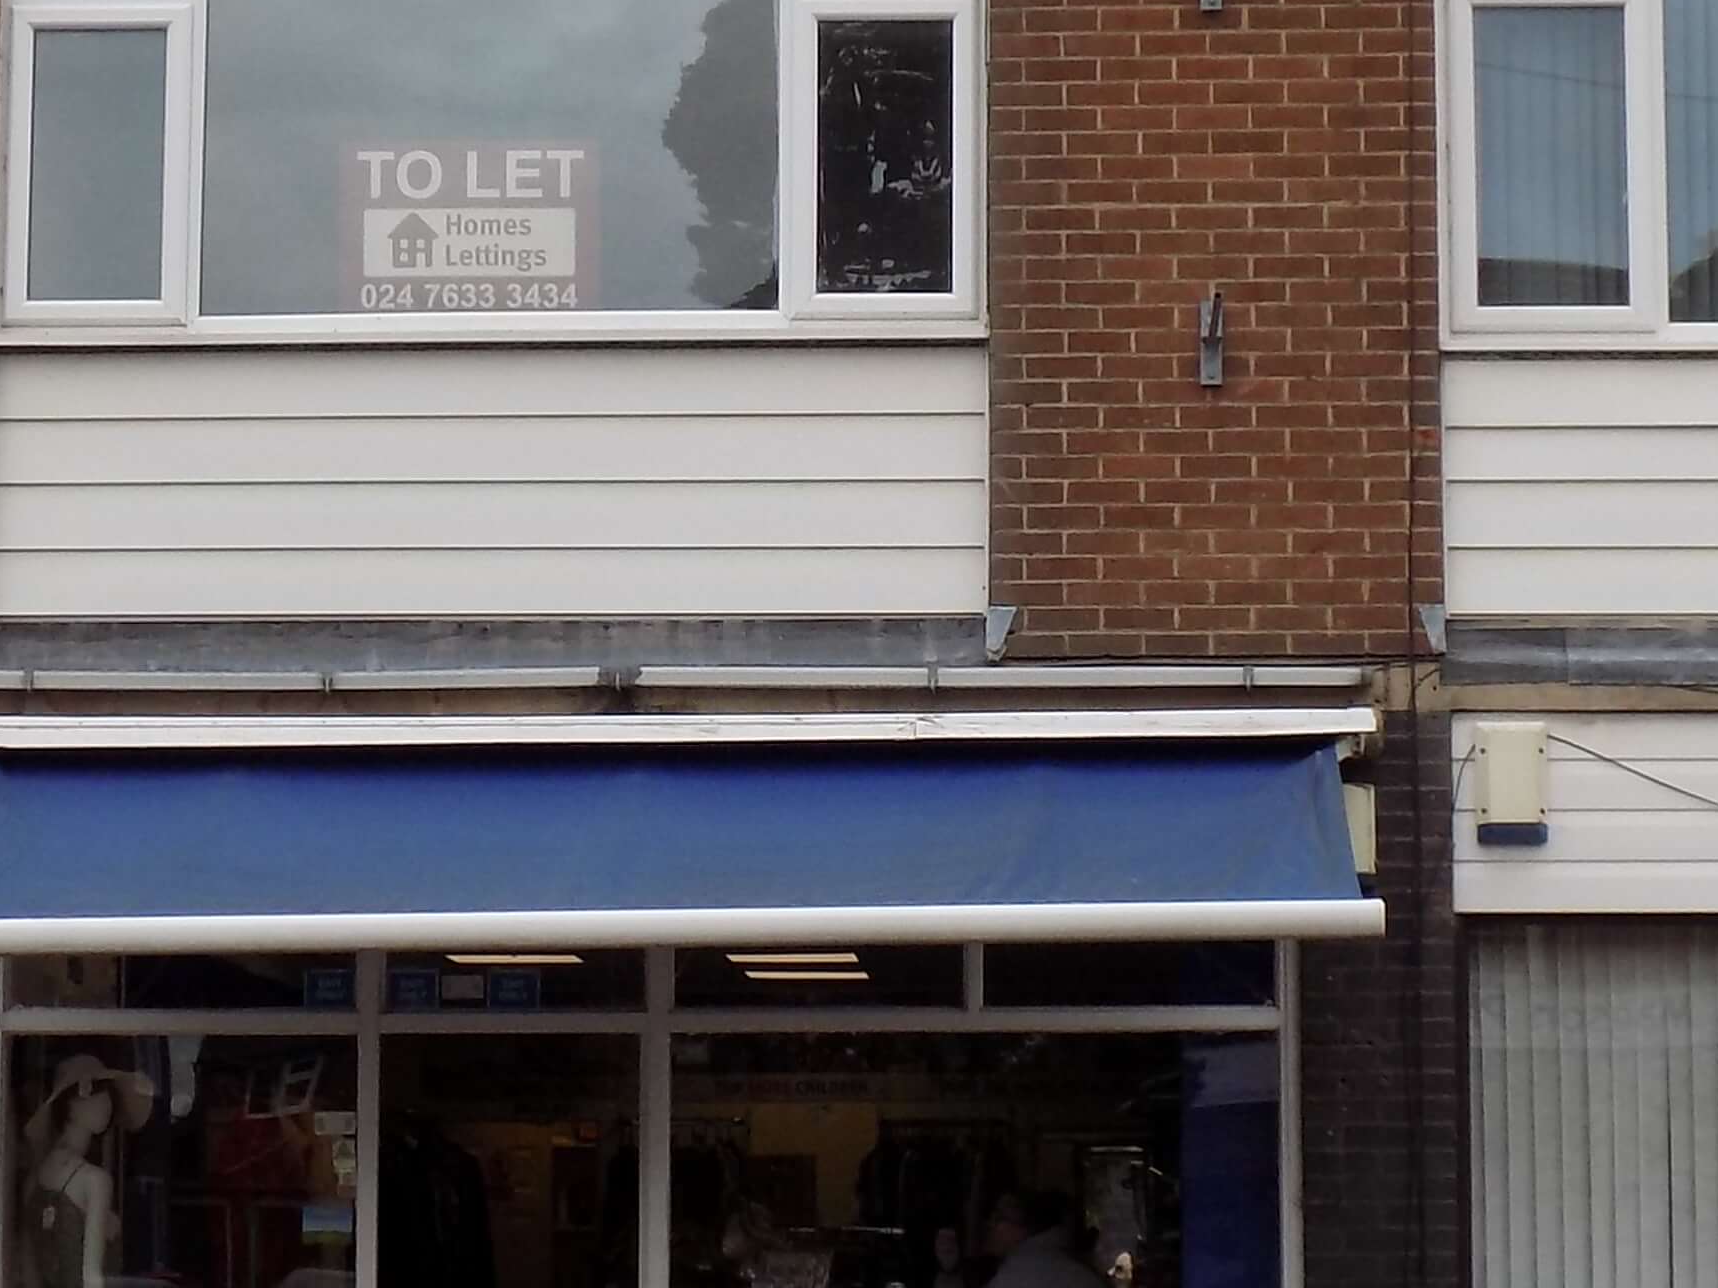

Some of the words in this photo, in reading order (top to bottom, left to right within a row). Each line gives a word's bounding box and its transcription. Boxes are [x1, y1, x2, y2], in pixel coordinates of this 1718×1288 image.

[357, 150, 443, 199] TO
[466, 150, 584, 198] LET
[445, 213, 532, 236] Homes
[445, 244, 547, 272] Lettings
[360, 283, 414, 309] 024
[424, 283, 496, 309] 7633
[506, 283, 578, 309] 3434
